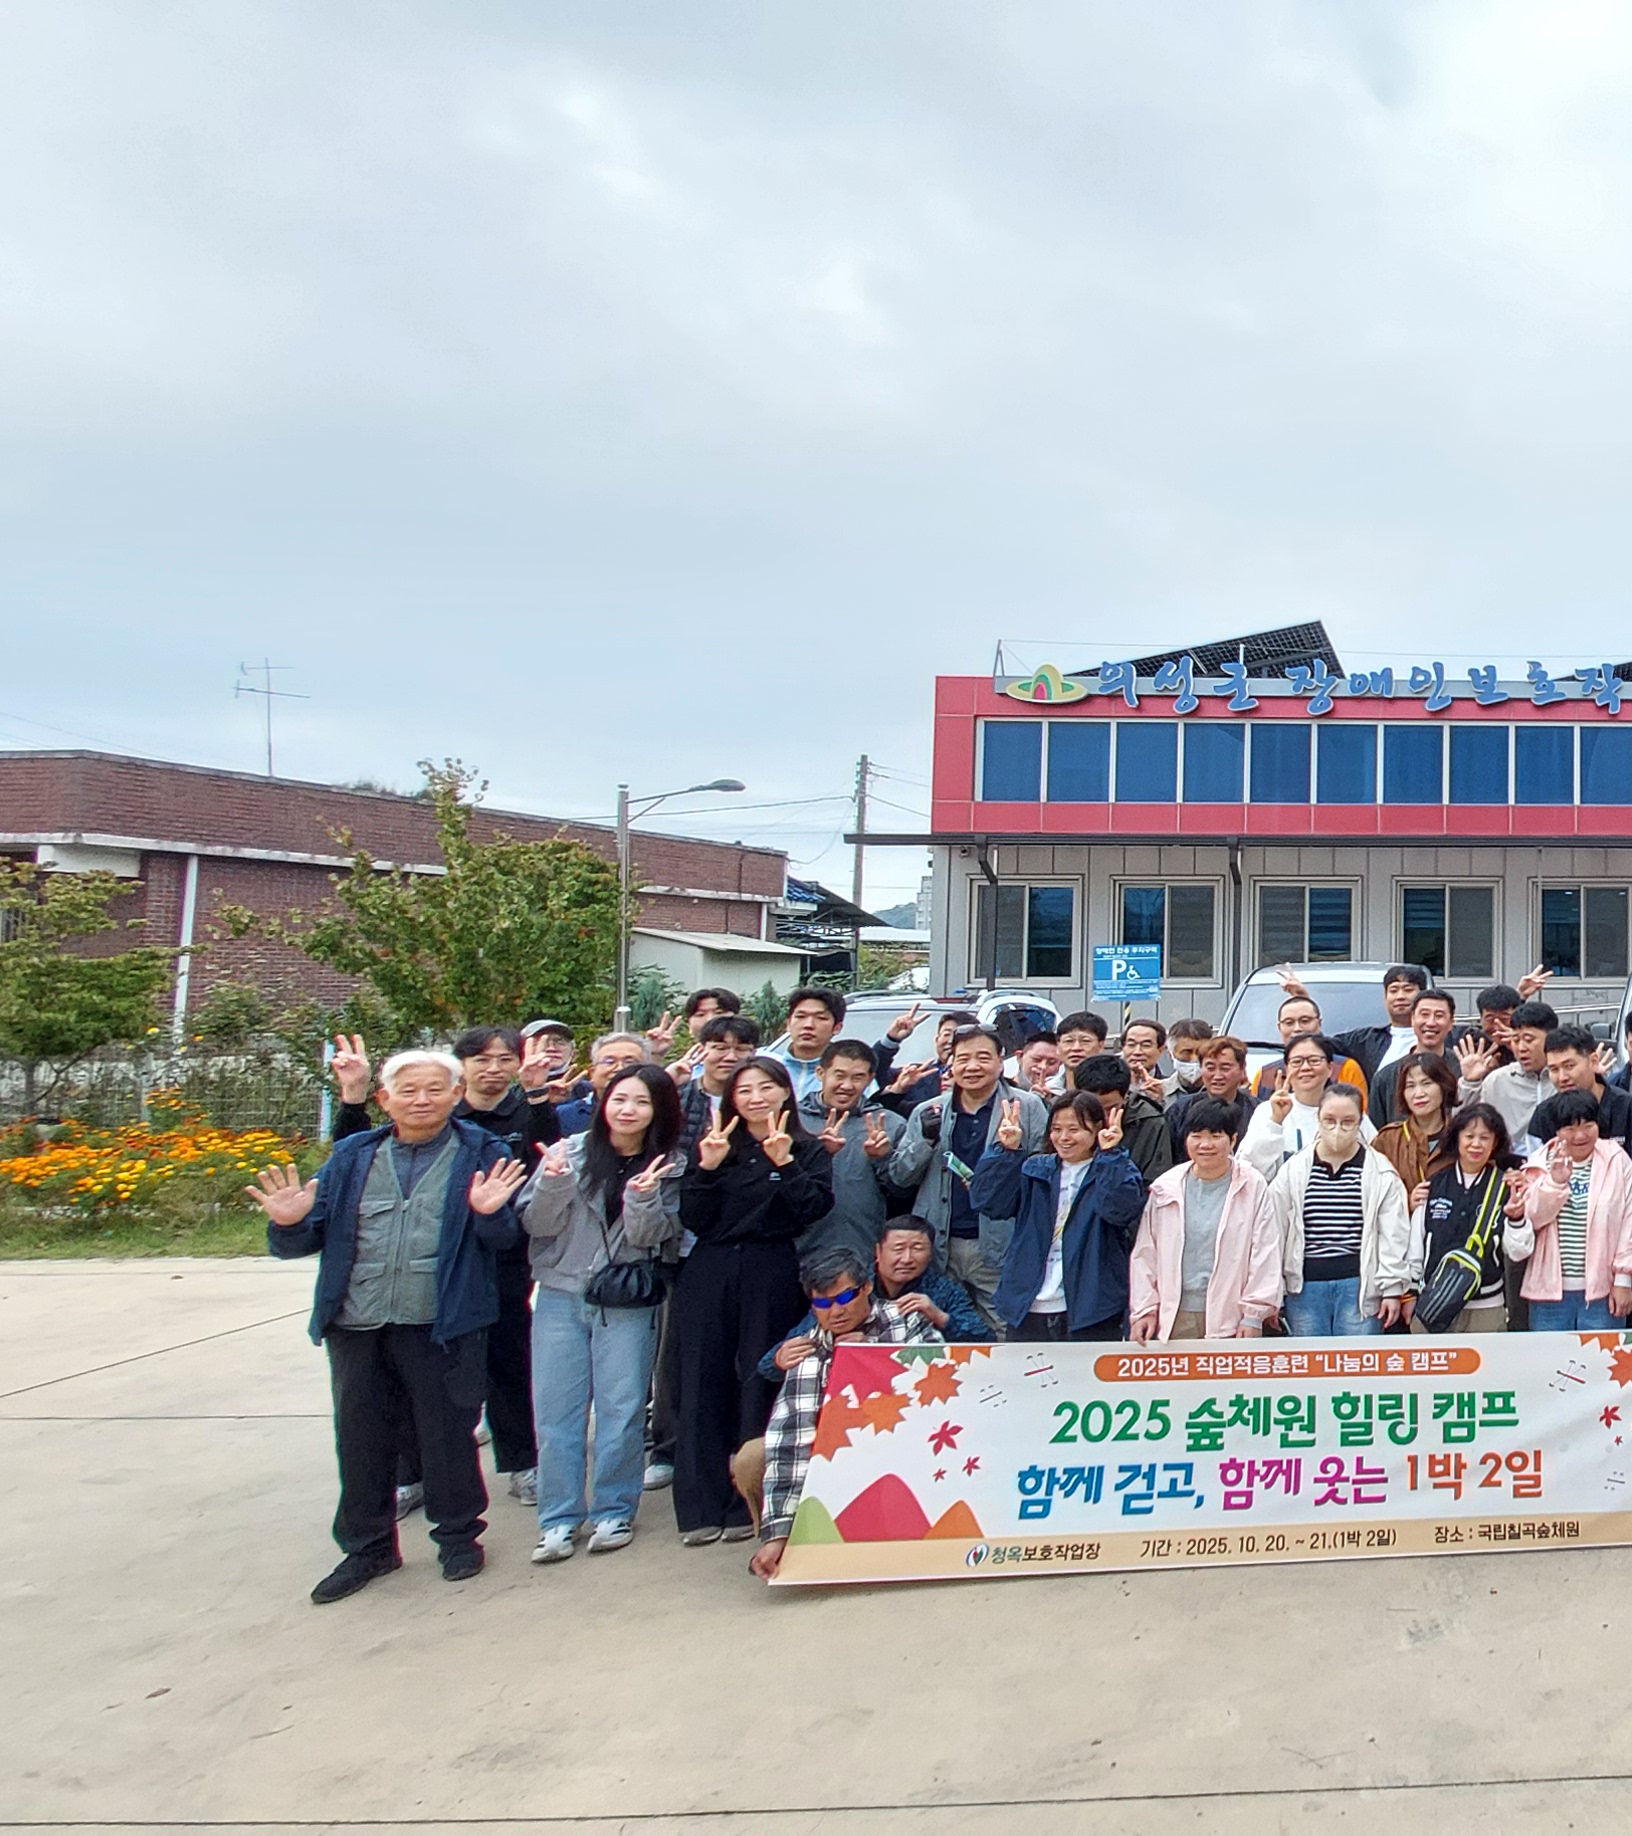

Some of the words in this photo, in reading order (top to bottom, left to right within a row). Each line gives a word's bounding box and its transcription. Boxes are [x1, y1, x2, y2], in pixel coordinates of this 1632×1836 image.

[1112, 959, 1127, 980] P
[1117, 1357, 1190, 1377] 2025년
[1195, 1354, 1309, 1375] 직업적응훈련
[1385, 1352, 1405, 1372] 숲
[1048, 1399, 1172, 1444] 2025
[1184, 1393, 1317, 1451] 숲체원
[1330, 1391, 1419, 1446] 힐링
[1431, 1390, 1520, 1444] 캠프
[1017, 1463, 1104, 1520] 함께
[1114, 1461, 1206, 1516] 걷고,
[1218, 1455, 1301, 1511] 함께
[1312, 1455, 1389, 1506] 웃는
[1406, 1452, 1467, 1500] 1박
[1477, 1449, 1543, 1499] 2일
[991, 1542, 1101, 1564] 청옥보호작업장
[1140, 1538, 1172, 1558] 기간
[1186, 1537, 1232, 1556] 2025.
[1238, 1536, 1260, 1553] 10.
[1265, 1534, 1290, 1552] 20.
[1366, 1528, 1398, 1547] 2일)
[1434, 1525, 1465, 1543] 장소
[1477, 1520, 1580, 1542] 국립칠곡숲체원
